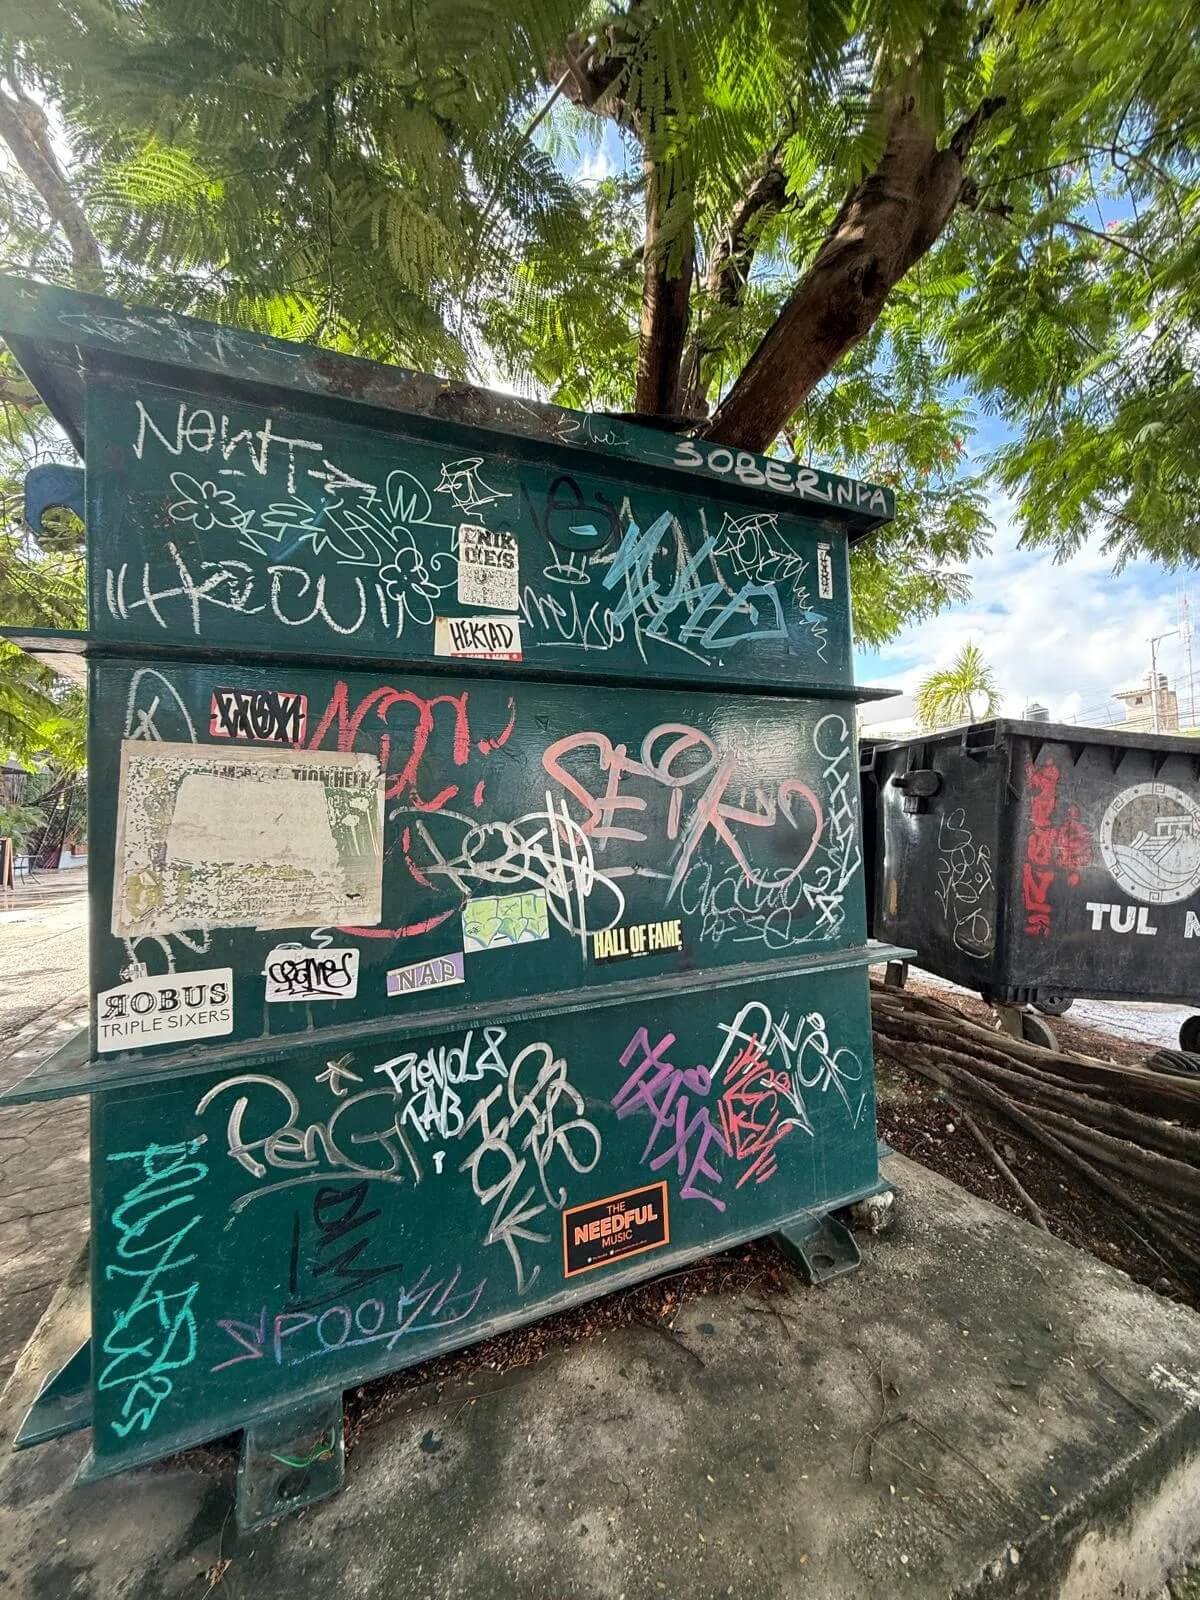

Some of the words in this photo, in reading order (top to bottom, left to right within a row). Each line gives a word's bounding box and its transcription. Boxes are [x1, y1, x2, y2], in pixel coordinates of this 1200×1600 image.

[449, 620, 514, 652] HEKTAD
[593, 927, 629, 959] HALL
[629, 924, 647, 952] OF
[648, 919, 683, 951] FAME
[396, 958, 456, 991] NAP
[101, 1017, 162, 1038] TRIPLE
[167, 1009, 230, 1029] SIXERS
[607, 1201, 626, 1215] THE
[574, 1204, 658, 1246] NEEDFUL
[602, 1229, 633, 1248] MUSIC
